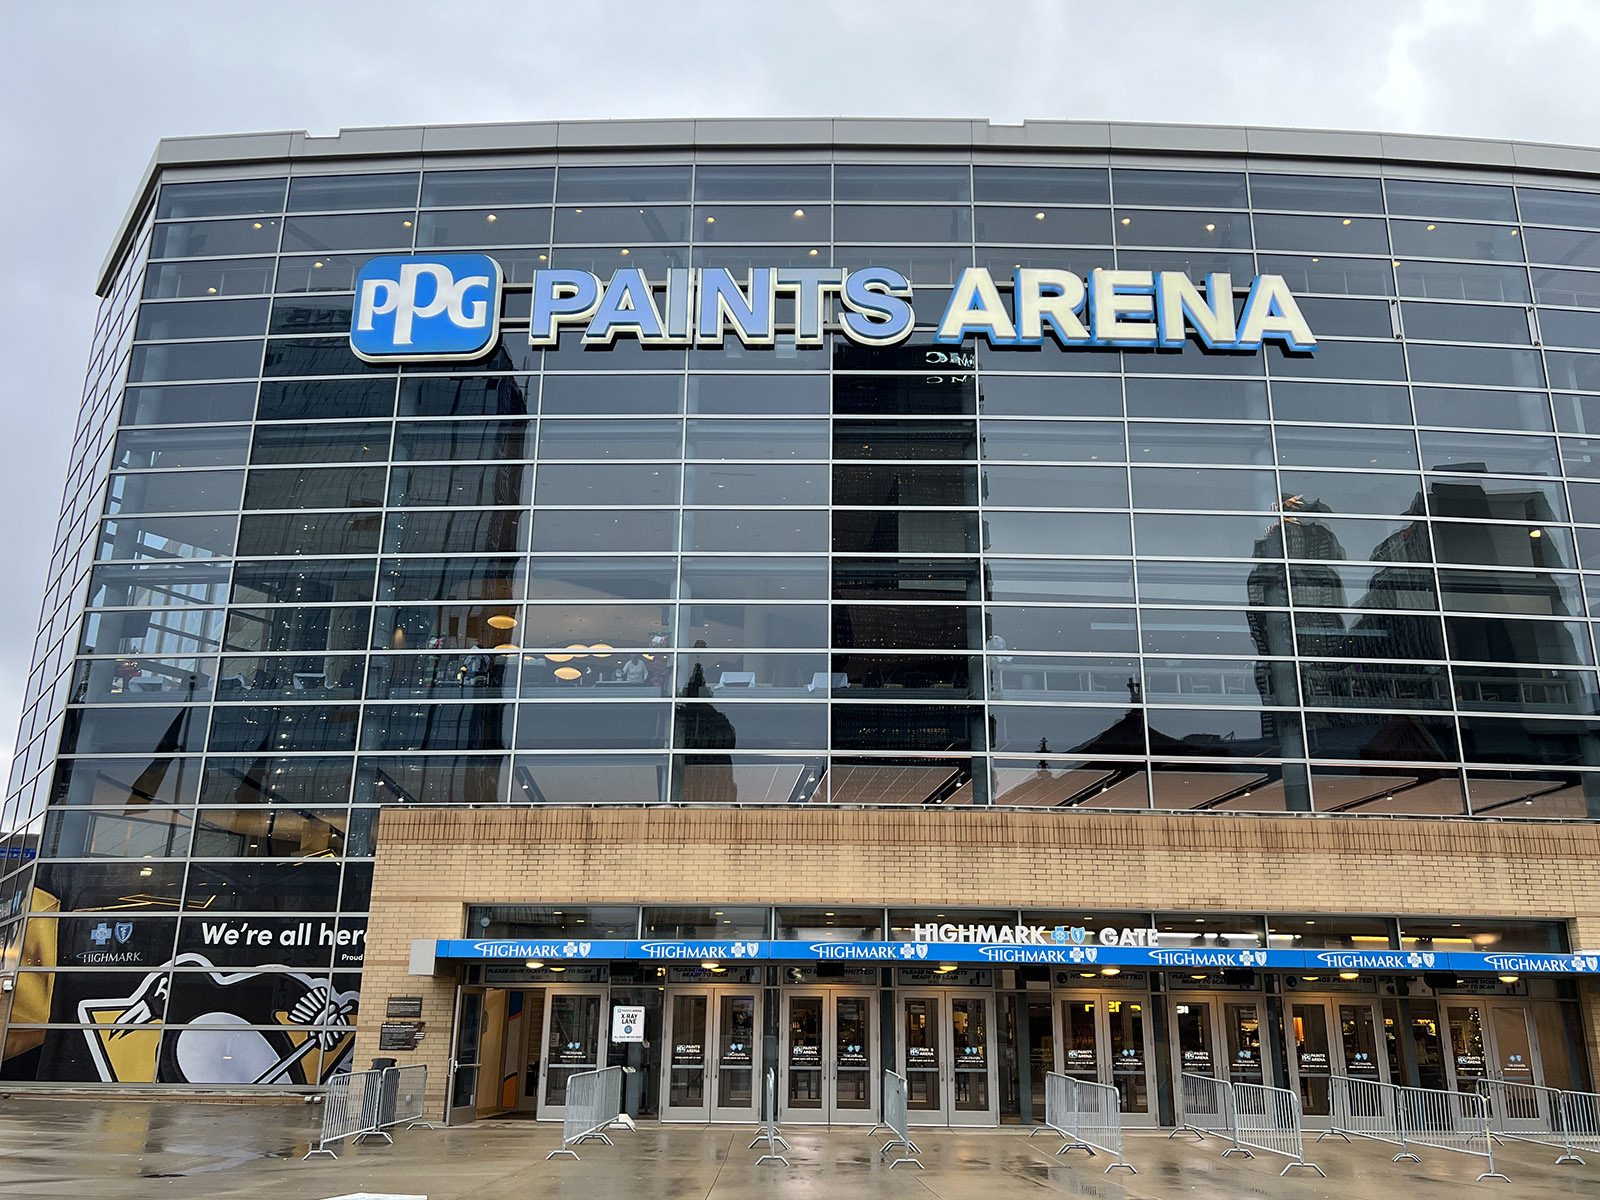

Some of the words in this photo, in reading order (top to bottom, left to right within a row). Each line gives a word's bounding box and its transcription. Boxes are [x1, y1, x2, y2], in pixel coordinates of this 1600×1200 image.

[357, 263, 489, 345] PPG
[528, 267, 915, 347] PAINTS
[933, 267, 1319, 352] ARENA
[201, 922, 273, 946] We're
[280, 922, 312, 946] all
[914, 923, 1047, 945] HIGHMARK
[1099, 927, 1159, 947] GATE
[77, 951, 142, 963] HIGHMARK
[341, 953, 364, 961] Proud
[474, 942, 560, 957] HIGHMARK
[641, 942, 727, 958] HIGHMARK
[809, 943, 897, 958] HIGHMARK
[978, 946, 1067, 962] HIGHMARK
[1148, 949, 1237, 966] HIGHMARK
[1317, 952, 1405, 967] HIGHMARK
[1484, 954, 1569, 971] HIGHMARK
